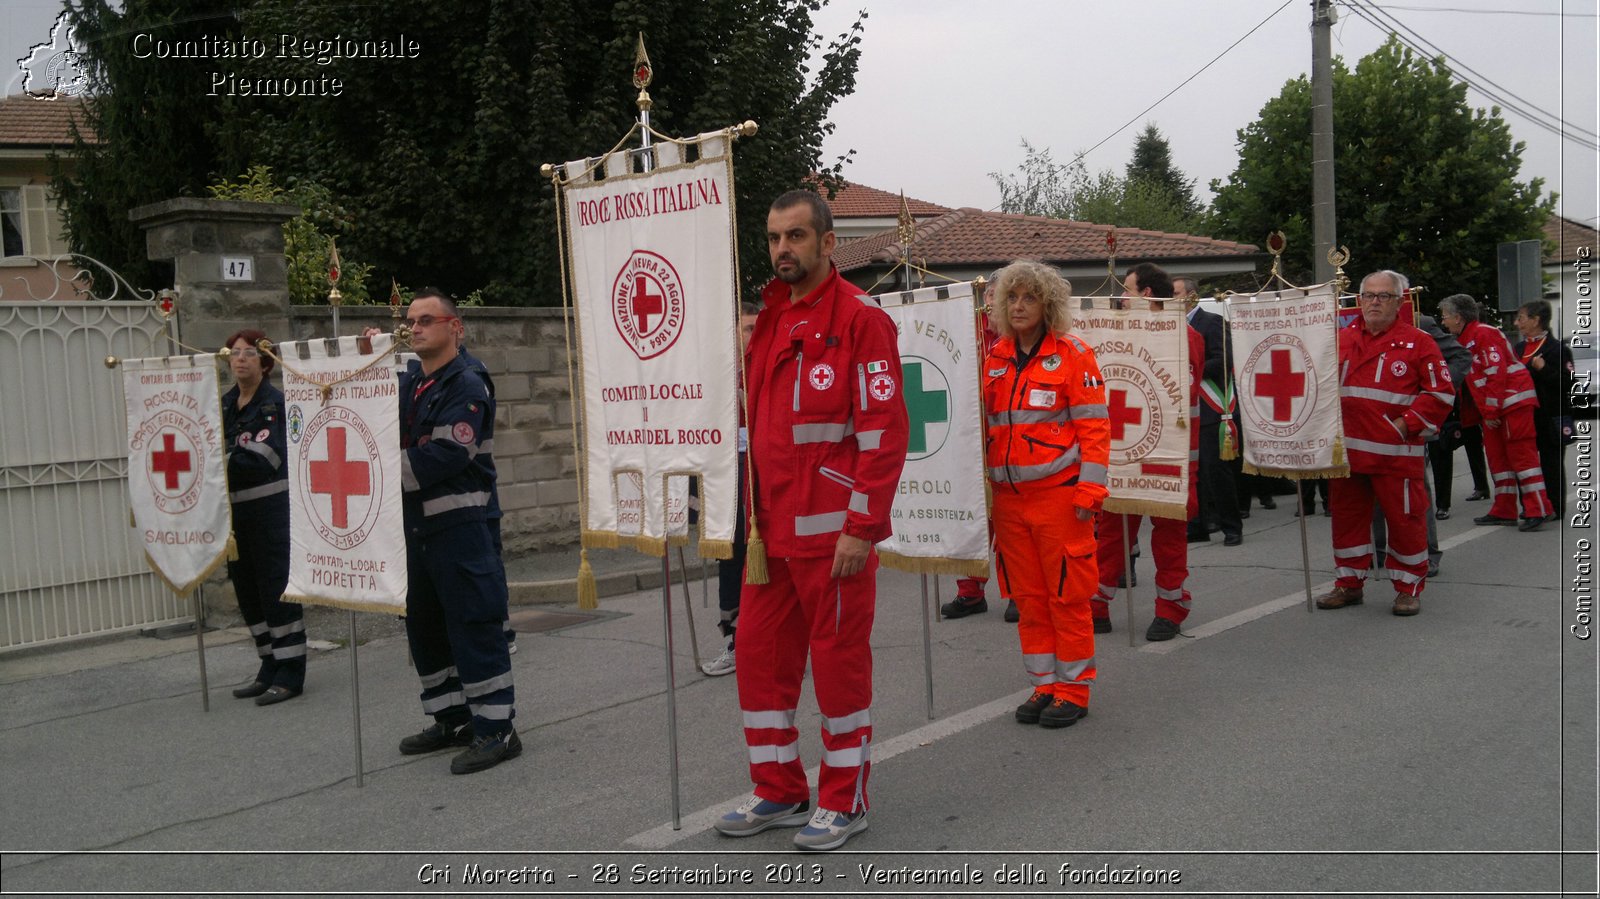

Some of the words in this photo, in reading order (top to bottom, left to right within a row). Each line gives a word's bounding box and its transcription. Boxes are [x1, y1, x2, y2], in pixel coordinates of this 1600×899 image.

[229, 261, 246, 278] 47
[658, 268, 671, 283] 22
[666, 282, 681, 328] AGOSTO
[1284, 306, 1298, 316] DEL
[1128, 320, 1143, 330] DEL
[1231, 321, 1261, 331] CROCE
[649, 328, 672, 349] 1864
[914, 319, 962, 364] VERDE
[1137, 346, 1183, 406] ITALIANA
[351, 383, 396, 399] ITALIANA
[649, 383, 703, 400] LOCALE
[143, 391, 180, 412] ROSSA
[647, 428, 675, 445] DEL
[677, 428, 723, 445] BOSCO
[1111, 477, 1123, 488] DI
[908, 508, 975, 521] ASSISTENZA
[916, 534, 941, 543] 1913
[312, 568, 377, 591] MORETTA
